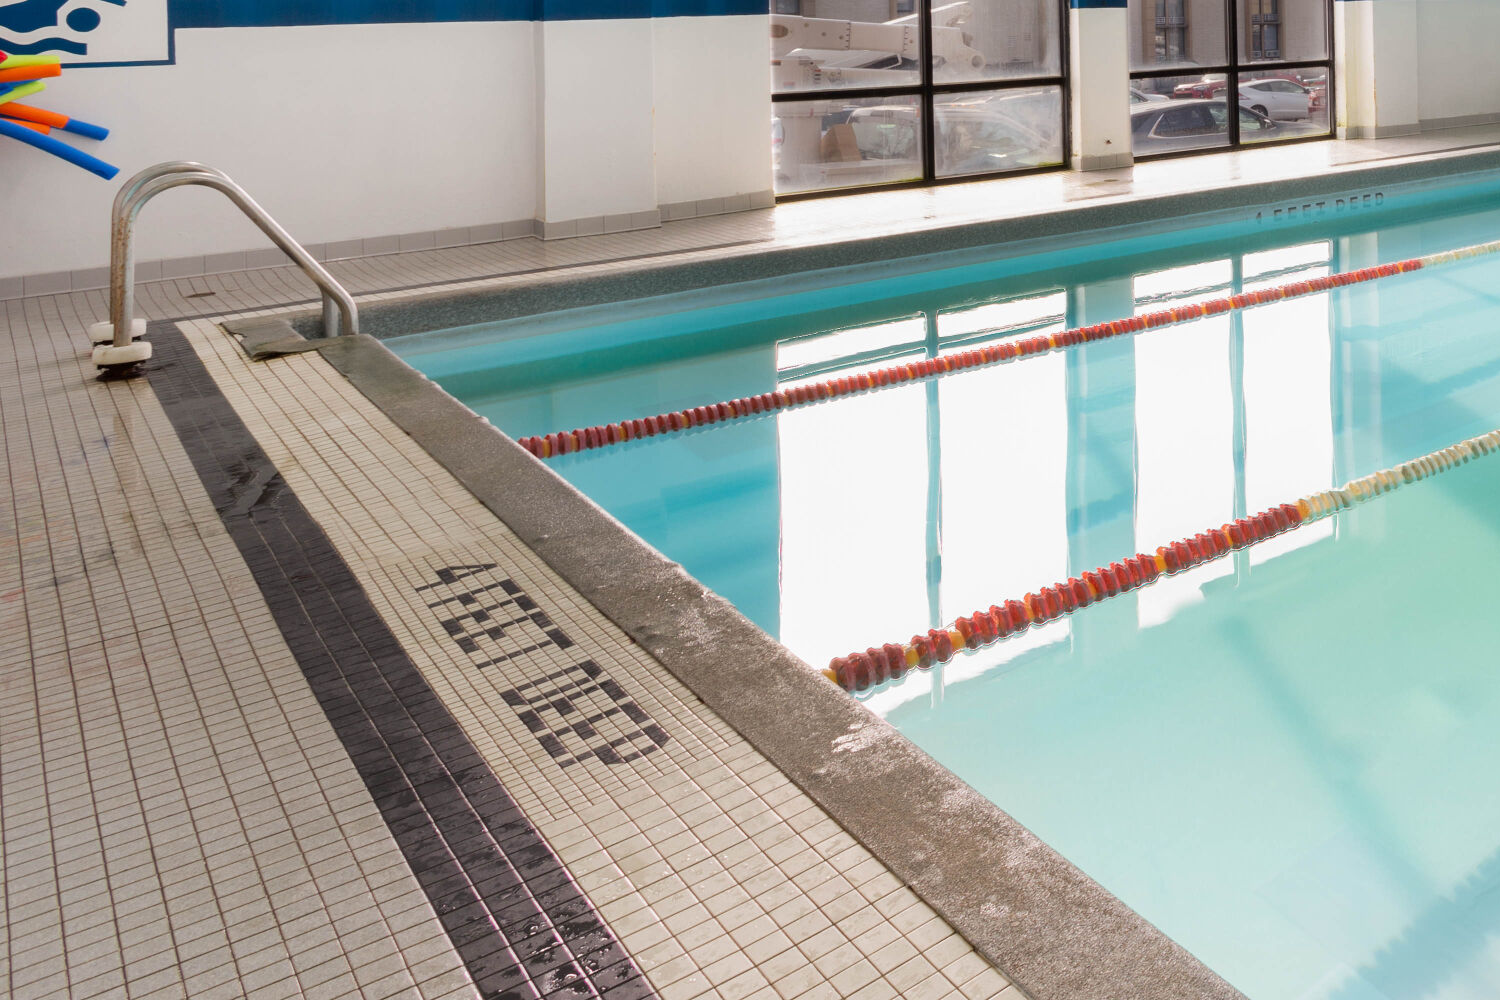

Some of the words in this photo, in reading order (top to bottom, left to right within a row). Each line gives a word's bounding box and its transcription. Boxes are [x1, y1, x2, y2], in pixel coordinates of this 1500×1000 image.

[414, 562, 498, 593] 4
[427, 578, 575, 671] FEET
[499, 658, 672, 769] DEEP
